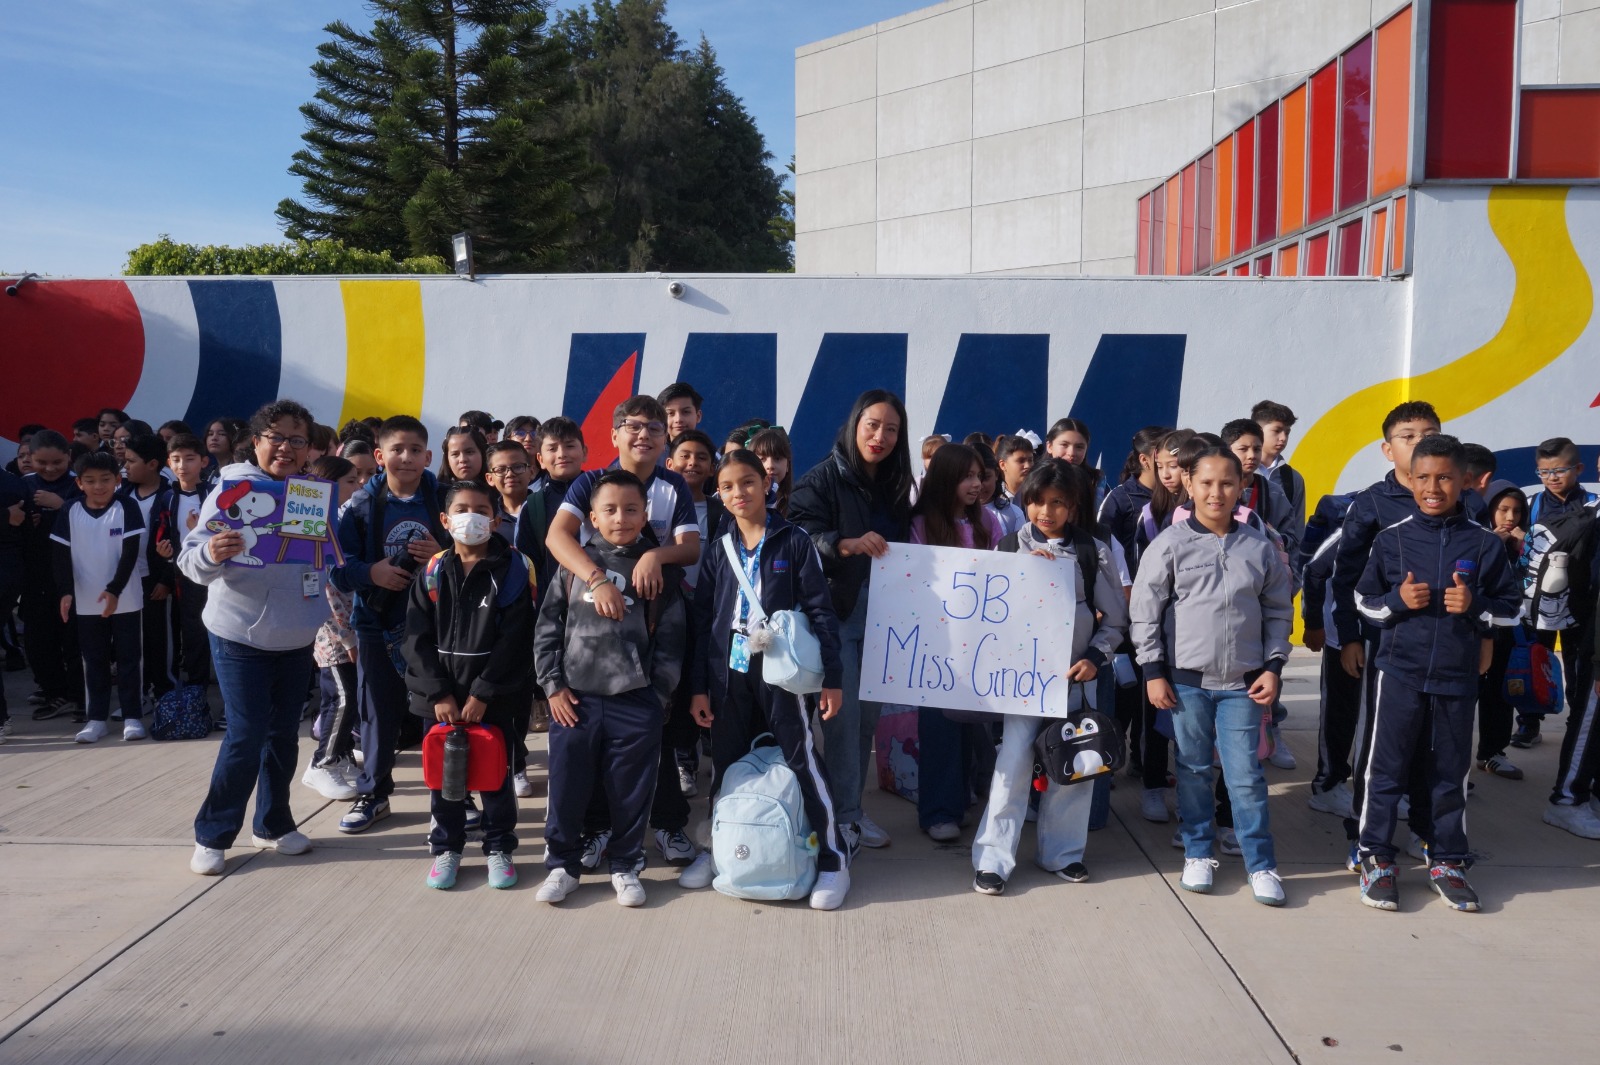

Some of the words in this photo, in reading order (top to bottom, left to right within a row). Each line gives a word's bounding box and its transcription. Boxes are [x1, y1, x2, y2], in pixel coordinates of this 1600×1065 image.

[289, 483, 323, 499] Miss:
[287, 501, 324, 517] Silvia
[301, 519, 327, 536] 5C
[388, 522, 413, 541] NIAGARA
[942, 571, 1010, 624] 5B
[882, 624, 955, 692] Miss
[971, 632, 1058, 713] Cindy
